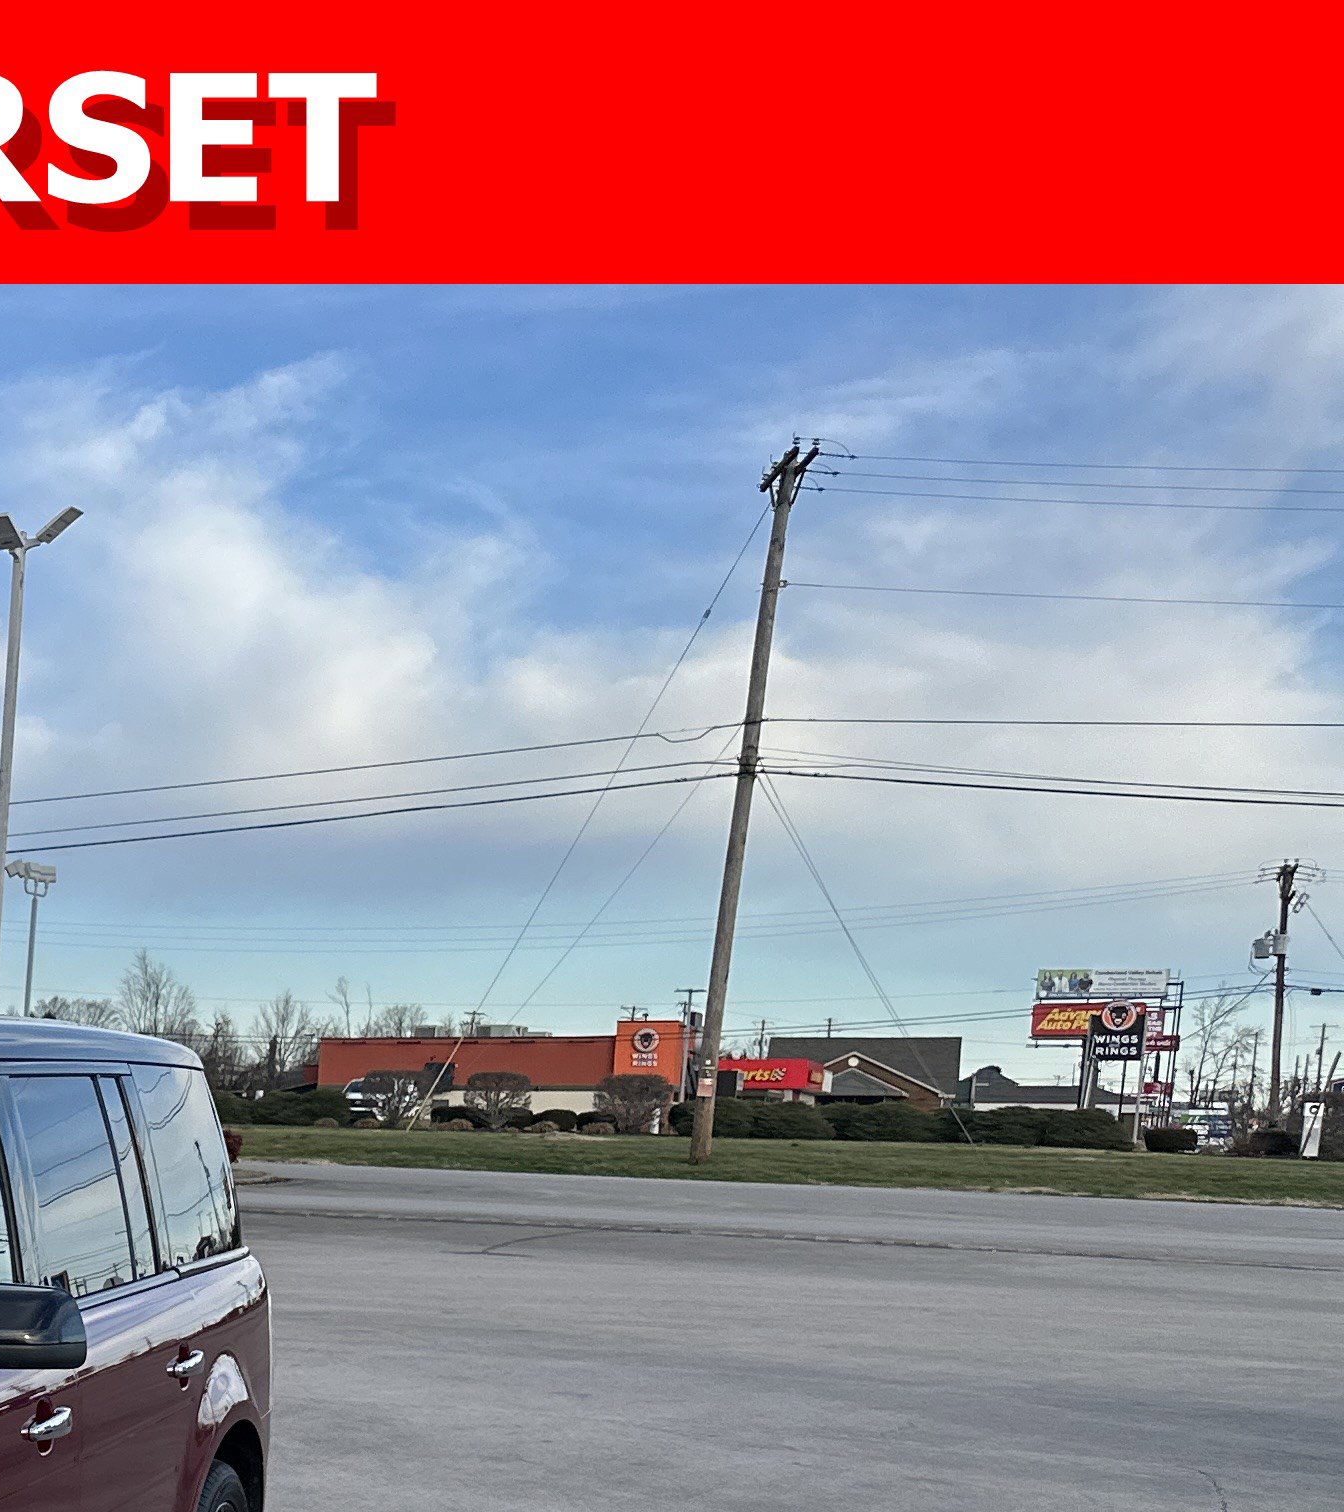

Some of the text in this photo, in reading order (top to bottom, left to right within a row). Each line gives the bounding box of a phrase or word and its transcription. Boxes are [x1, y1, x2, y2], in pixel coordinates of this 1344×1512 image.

[1043, 1008, 1102, 1021] Advan
[1036, 1020, 1072, 1031] Auto
[1093, 1034, 1139, 1044] WINGS
[1095, 1046, 1138, 1055] RINGS
